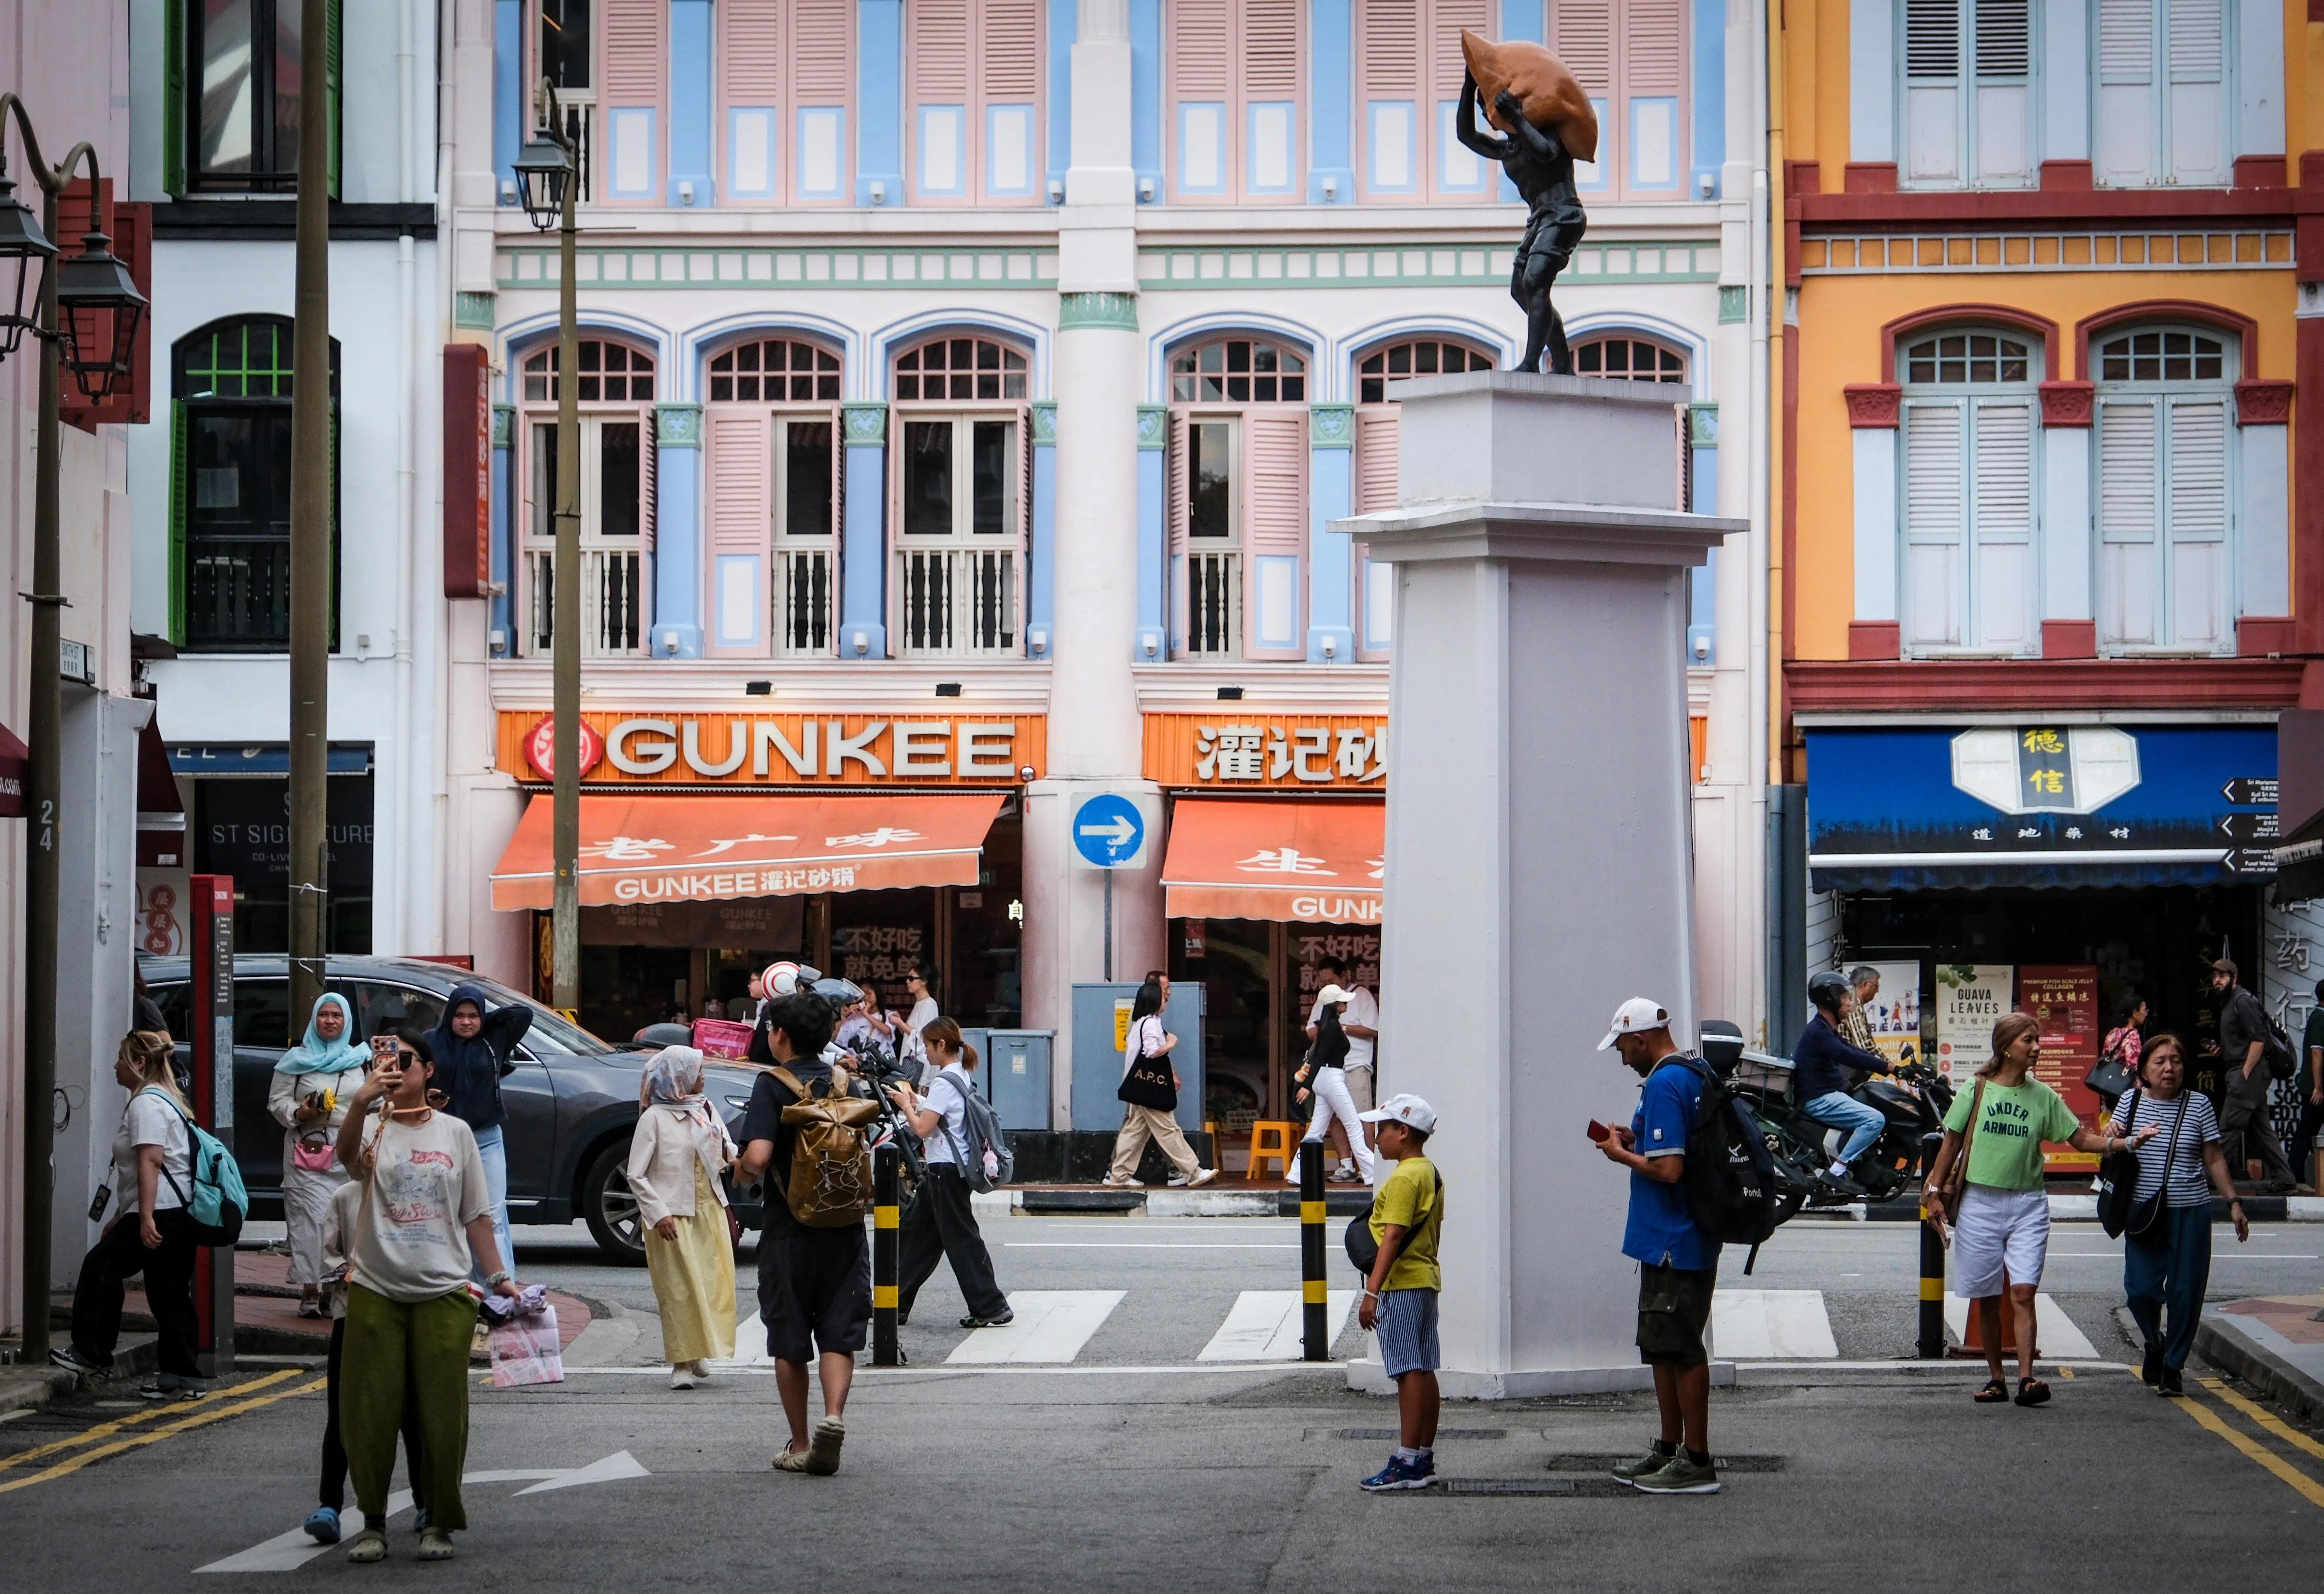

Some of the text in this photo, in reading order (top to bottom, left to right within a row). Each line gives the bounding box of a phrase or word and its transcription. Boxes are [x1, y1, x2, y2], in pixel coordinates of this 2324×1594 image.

[62, 642, 78, 659] SMITH ST
[606, 718, 1015, 776] GUNKEE
[212, 825, 373, 844] ST SIGURE
[614, 873, 757, 899] GUNKEE
[845, 926, 923, 953] 不好吃
[1299, 934, 1380, 962] 不好吃
[1299, 963, 1380, 991] 就单
[1958, 988, 1992, 1001] GUAVA
[1950, 1003, 1999, 1014] LEAVES
[1134, 1069, 1167, 1085] A.P.C.
[1987, 1102, 2029, 1121] UNDER
[1983, 1120, 2029, 1138] ARMOUR
